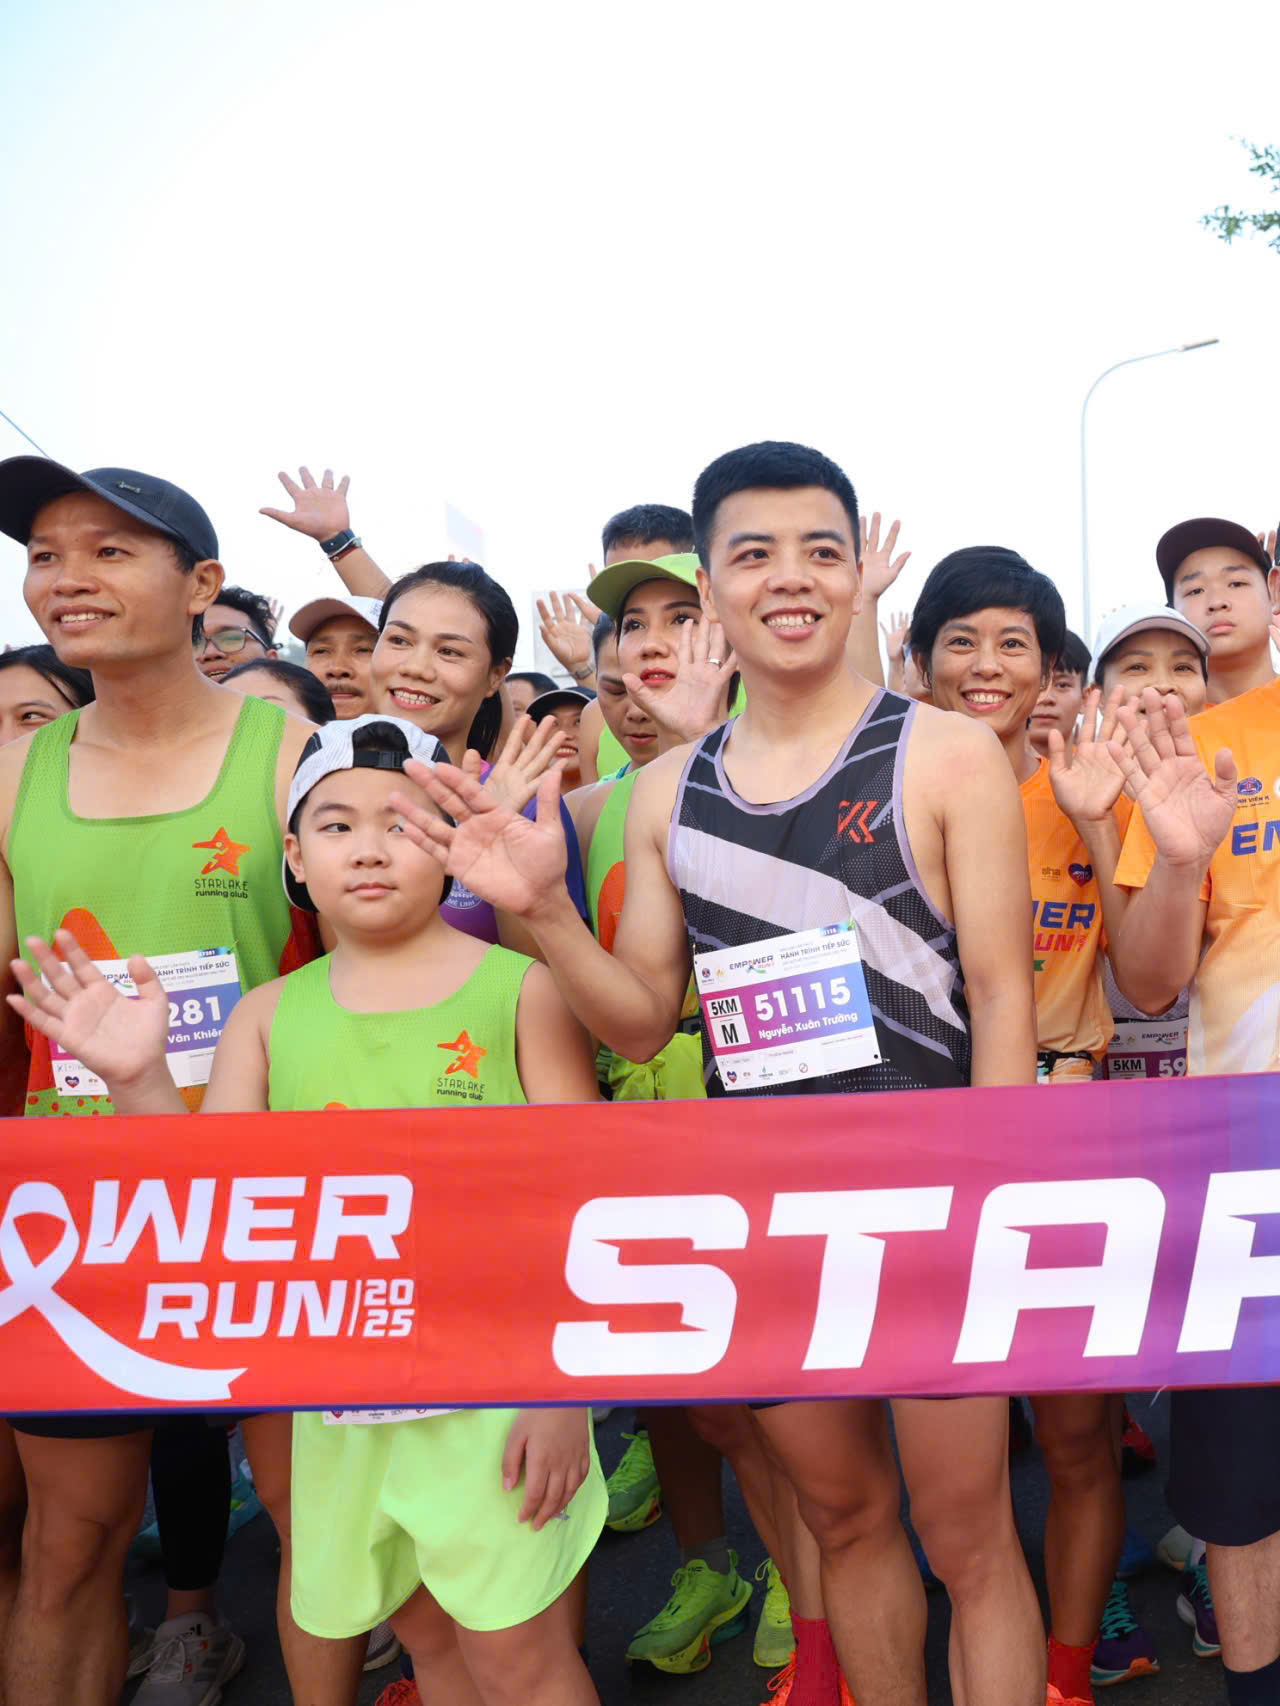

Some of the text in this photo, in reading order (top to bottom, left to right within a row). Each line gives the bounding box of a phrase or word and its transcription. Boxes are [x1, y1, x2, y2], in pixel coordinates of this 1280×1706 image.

[194, 878, 249, 891] STARLAKE
[195, 890, 248, 899] running club
[1033, 901, 1096, 930] ER
[729, 955, 774, 970] EMPOWER
[780, 950, 800, 960] HÀNH
[754, 976, 851, 1021] 51115
[711, 998, 738, 1016] 5KM
[721, 1022, 739, 1045] M
[758, 1025, 794, 1040] Nguyễn
[795, 1018, 821, 1032] Xuân
[1141, 1031, 1179, 1039] EMPOWER
[167, 1032, 191, 1044] Văn
[1113, 1059, 1142, 1071] 5KM
[437, 1078, 485, 1094] STARLAKE
[437, 1088, 483, 1101] running club
[364, 1279, 413, 1306] 20
[138, 1279, 348, 1339] RUN
[362, 1309, 413, 1337] 25
